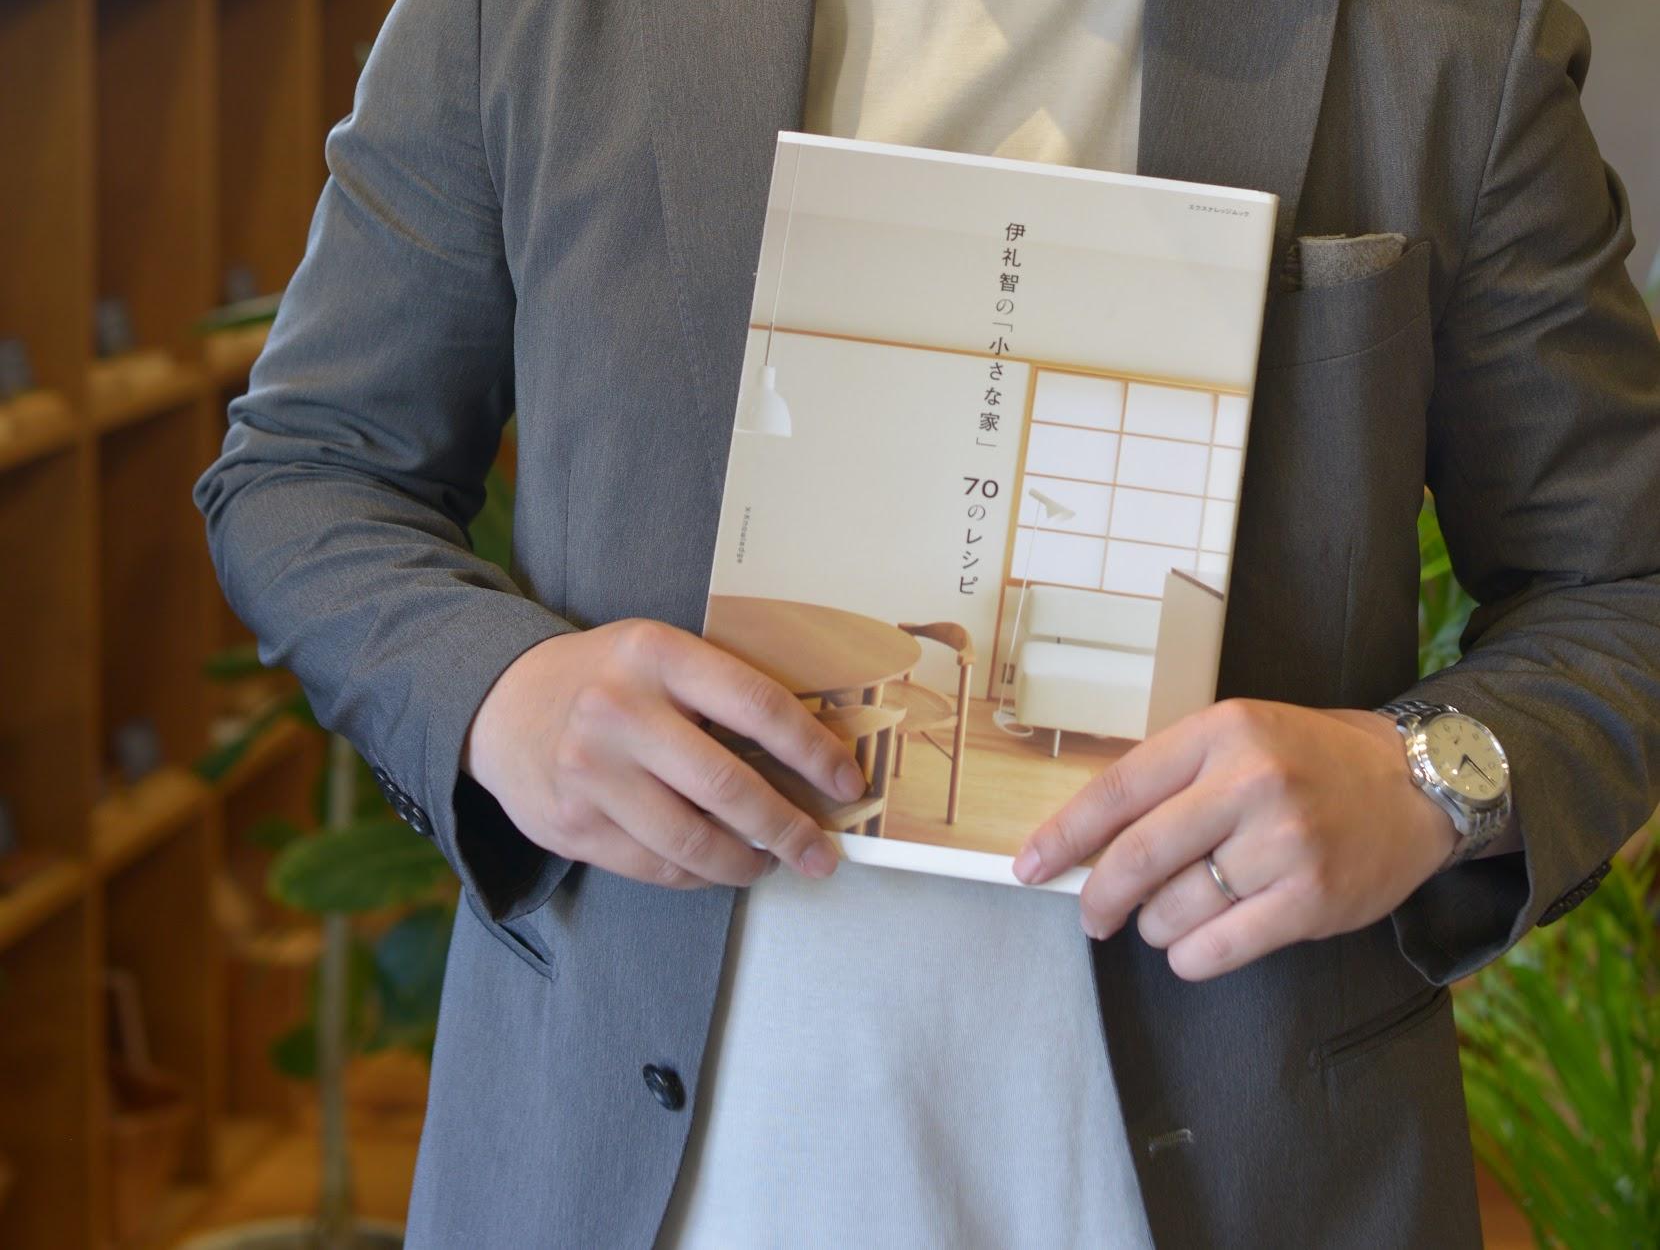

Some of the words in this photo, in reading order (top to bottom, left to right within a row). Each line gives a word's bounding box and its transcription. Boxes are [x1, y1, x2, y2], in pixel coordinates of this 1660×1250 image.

[975, 222, 1026, 448] 伊礼智の「小さな家」
[959, 476, 999, 595] 70のレシピ
